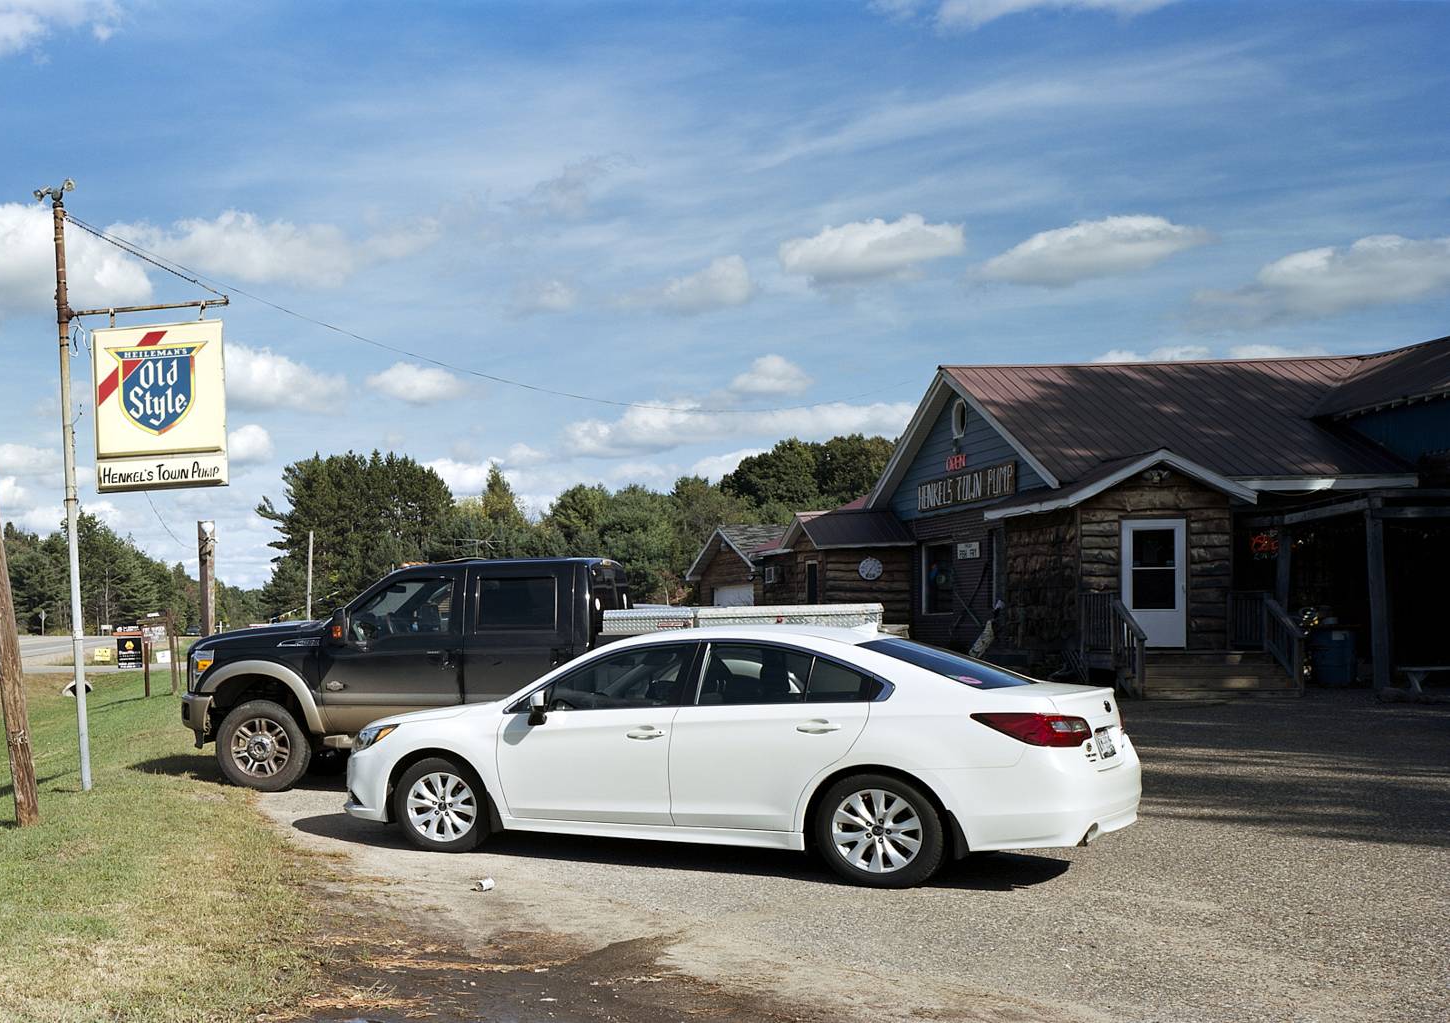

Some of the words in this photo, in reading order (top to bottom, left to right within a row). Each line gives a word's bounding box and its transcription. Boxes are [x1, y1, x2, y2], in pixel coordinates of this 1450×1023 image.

[124, 348, 187, 358] HEILEMAN'S
[140, 358, 178, 389] Old
[129, 386, 186, 426] Style
[102, 467, 154, 484] HENKEL'S
[156, 463, 188, 481] TOWN
[945, 454, 966, 471] OPEN
[956, 471, 982, 501] TOWN
[987, 464, 1013, 497] PUMP
